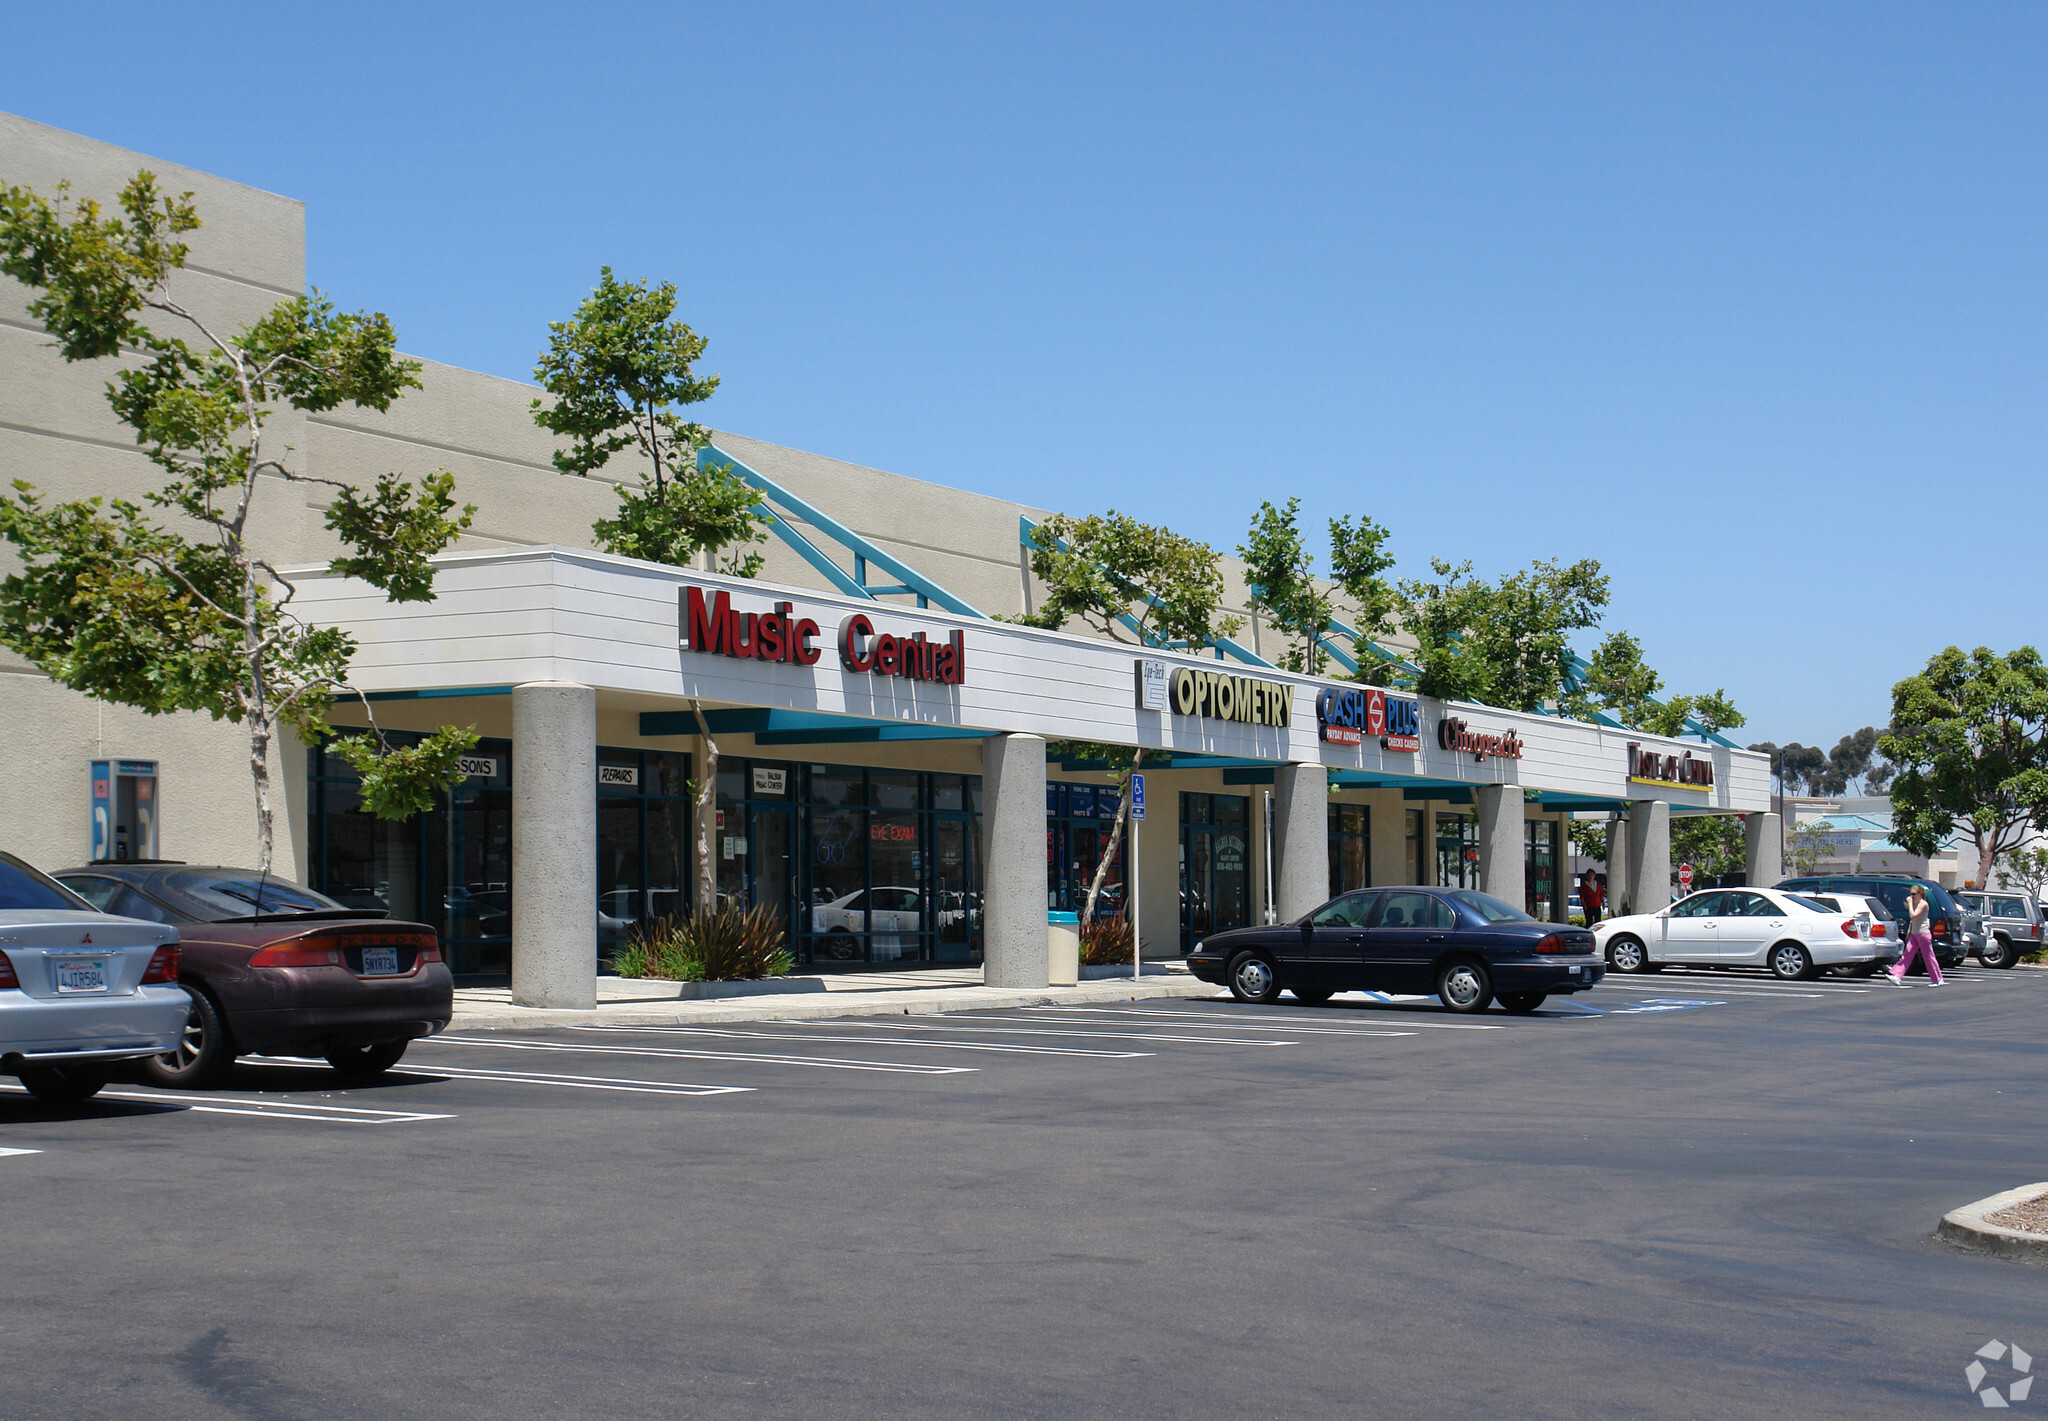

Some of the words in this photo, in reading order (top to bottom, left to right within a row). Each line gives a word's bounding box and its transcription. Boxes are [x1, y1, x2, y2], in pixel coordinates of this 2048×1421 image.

[684, 586, 822, 666] Music
[843, 613, 965, 685] Central
[1144, 662, 1165, 681] Eye-Tech
[1175, 667, 1295, 727] OPTOMETRY
[1322, 688, 1365, 728] CASH
[1387, 697, 1420, 735] PLUS
[1327, 728, 1342, 740] PAYDAY
[1343, 731, 1361, 742] ADVANCE
[1388, 737, 1403, 747] CHECKS
[1404, 739, 1419, 749] CASHED
[1444, 717, 1524, 762] Chiropractic
[602, 768, 632, 783] REPAIRS
[1664, 755, 1678, 780] OF
[1681, 750, 1714, 785] CHINA
[871, 824, 889, 840] EYE
[890, 826, 915, 840] EXAM
[1680, 870, 1692, 878] STOP
[365, 957, 396, 971] 5NYR734
[62, 971, 103, 987] 4JIR584
